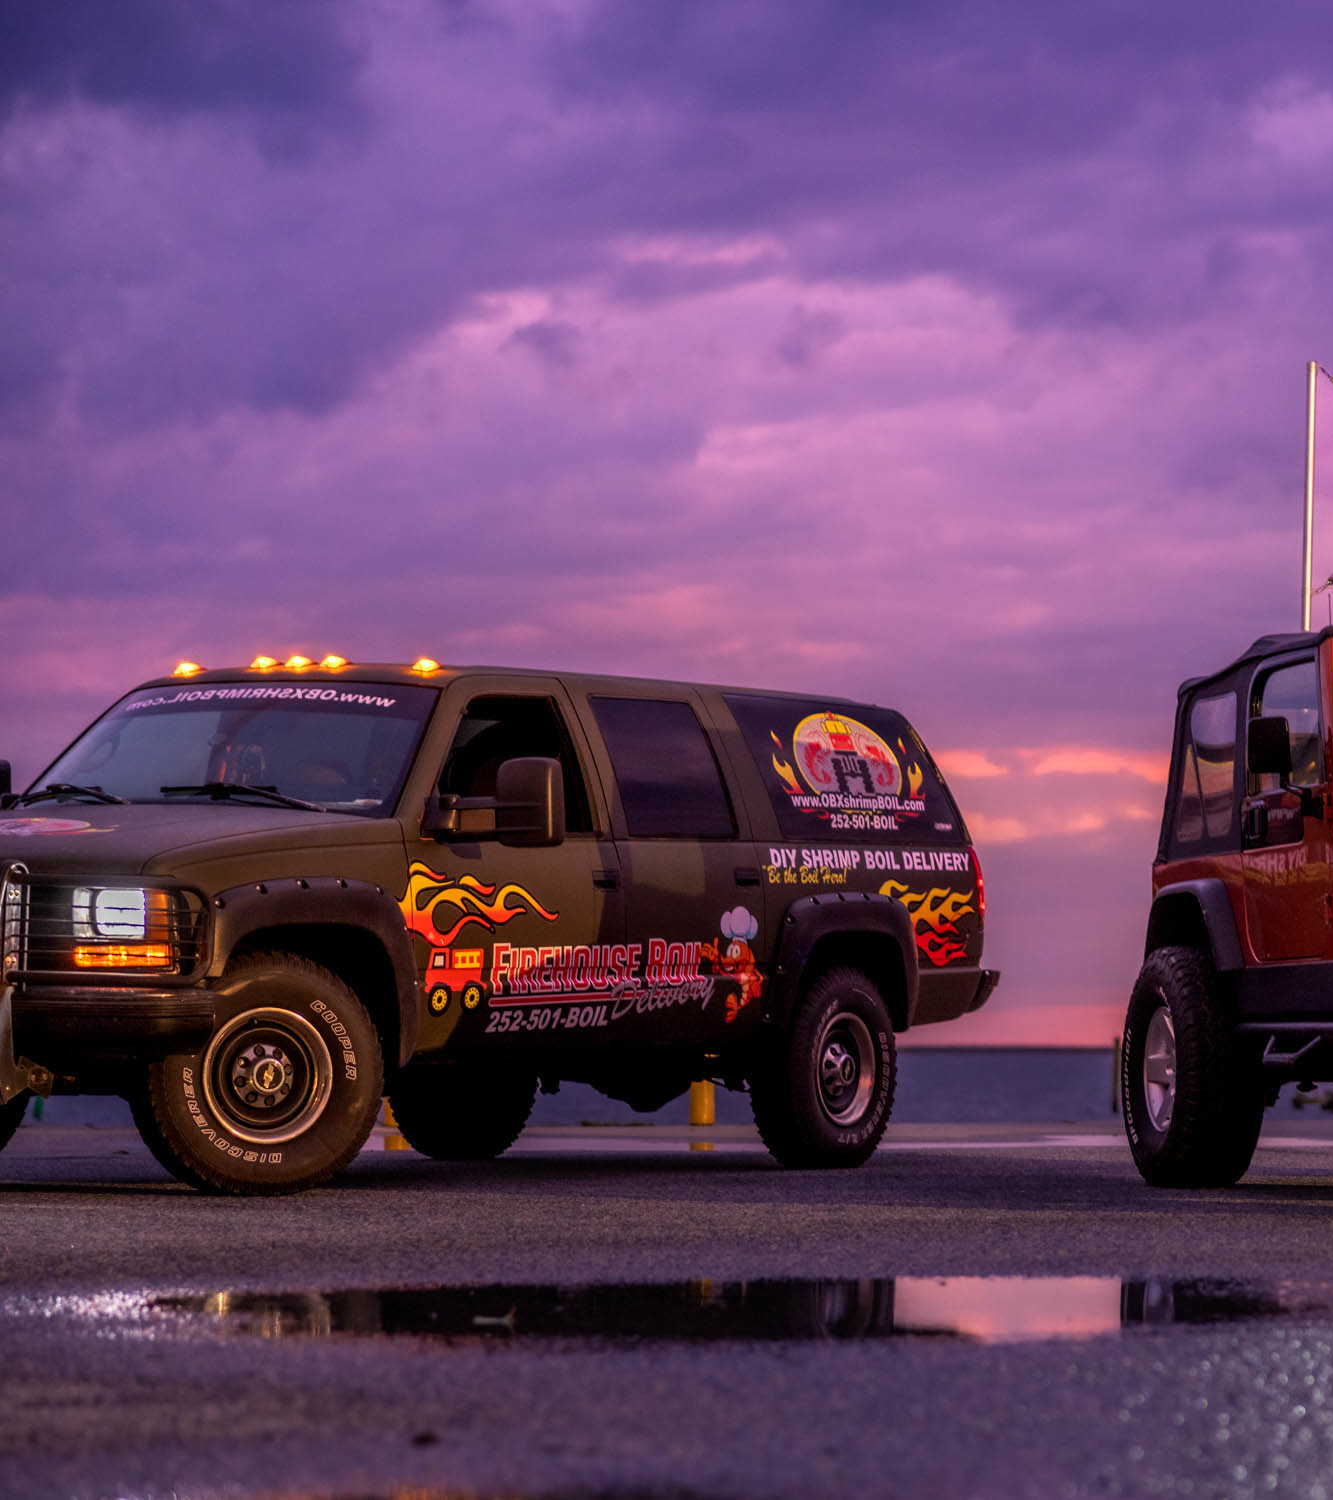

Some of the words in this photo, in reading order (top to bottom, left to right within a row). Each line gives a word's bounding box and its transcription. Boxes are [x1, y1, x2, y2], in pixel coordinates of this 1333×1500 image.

[791, 793, 925, 812] www.OBXshrimpBOIL.com
[830, 814, 898, 830] 252-501-BOIL
[769, 848, 797, 869] DIY
[801, 849, 861, 871] SHRIMP
[864, 851, 900, 871] BOIL
[902, 851, 970, 872] DELIVERY
[783, 867, 798, 884] the
[800, 866, 819, 884] Boil
[610, 978, 714, 1019] Delivery
[485, 1006, 608, 1034] 252-501-BOIL
[310, 1000, 357, 1080] COOPER
[183, 1066, 282, 1163] DISCOVERER
